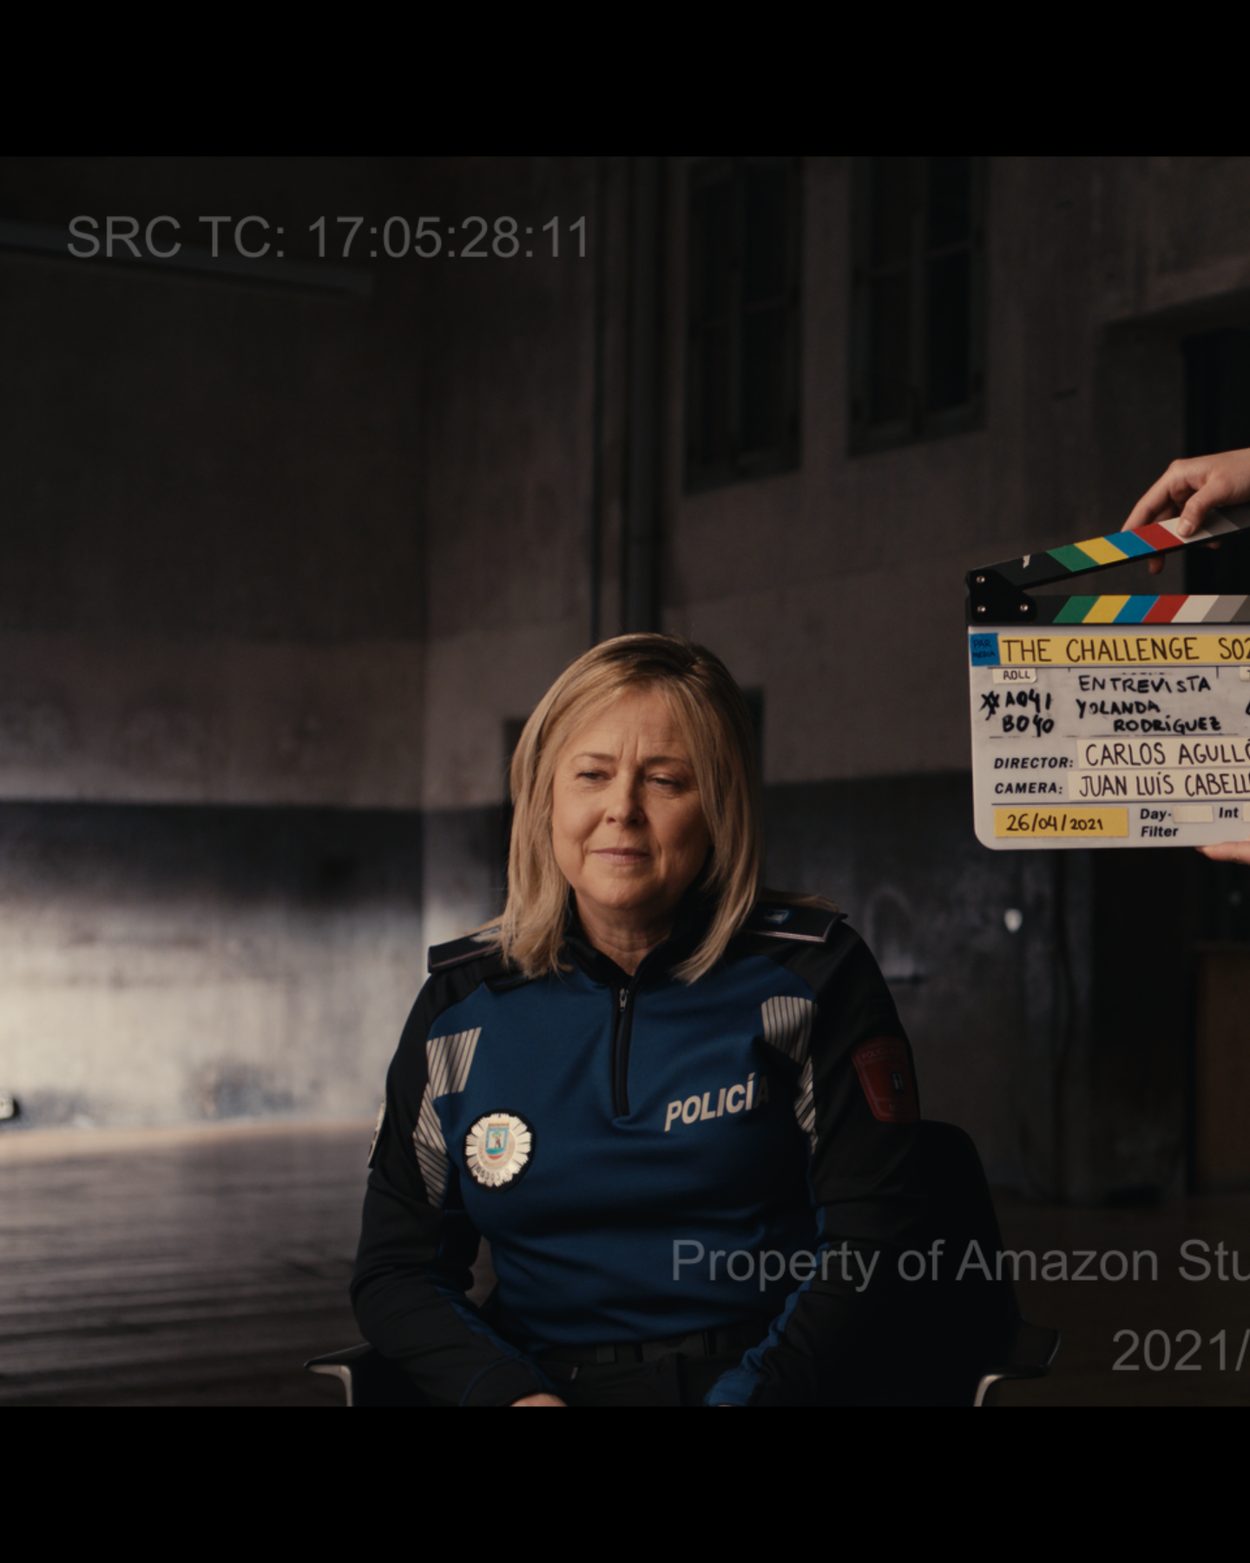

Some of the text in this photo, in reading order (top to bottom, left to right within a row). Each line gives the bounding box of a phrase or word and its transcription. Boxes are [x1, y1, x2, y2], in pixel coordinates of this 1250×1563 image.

[1002, 639, 1051, 662] THE
[1066, 637, 1199, 662] CHALLENGE
[1003, 670, 1030, 680] ROLL
[1079, 675, 1211, 693] ENTREVISTA
[1076, 699, 1160, 719] YOLANDA
[1003, 714, 1054, 735] B040
[1114, 715, 1221, 734] RODRÍGUEZ
[994, 757, 1073, 769] DIRECTOR:
[1086, 742, 1165, 766] CARLOS
[995, 782, 1063, 794] CAMERA:
[1080, 775, 1127, 797] JUAN
[1136, 772, 1174, 795] LUÍS
[1219, 807, 1238, 818] Int
[1007, 813, 1103, 832] 26/04/2021
[1141, 826, 1178, 837] Filter
[663, 1071, 771, 1133] POLICÍA
